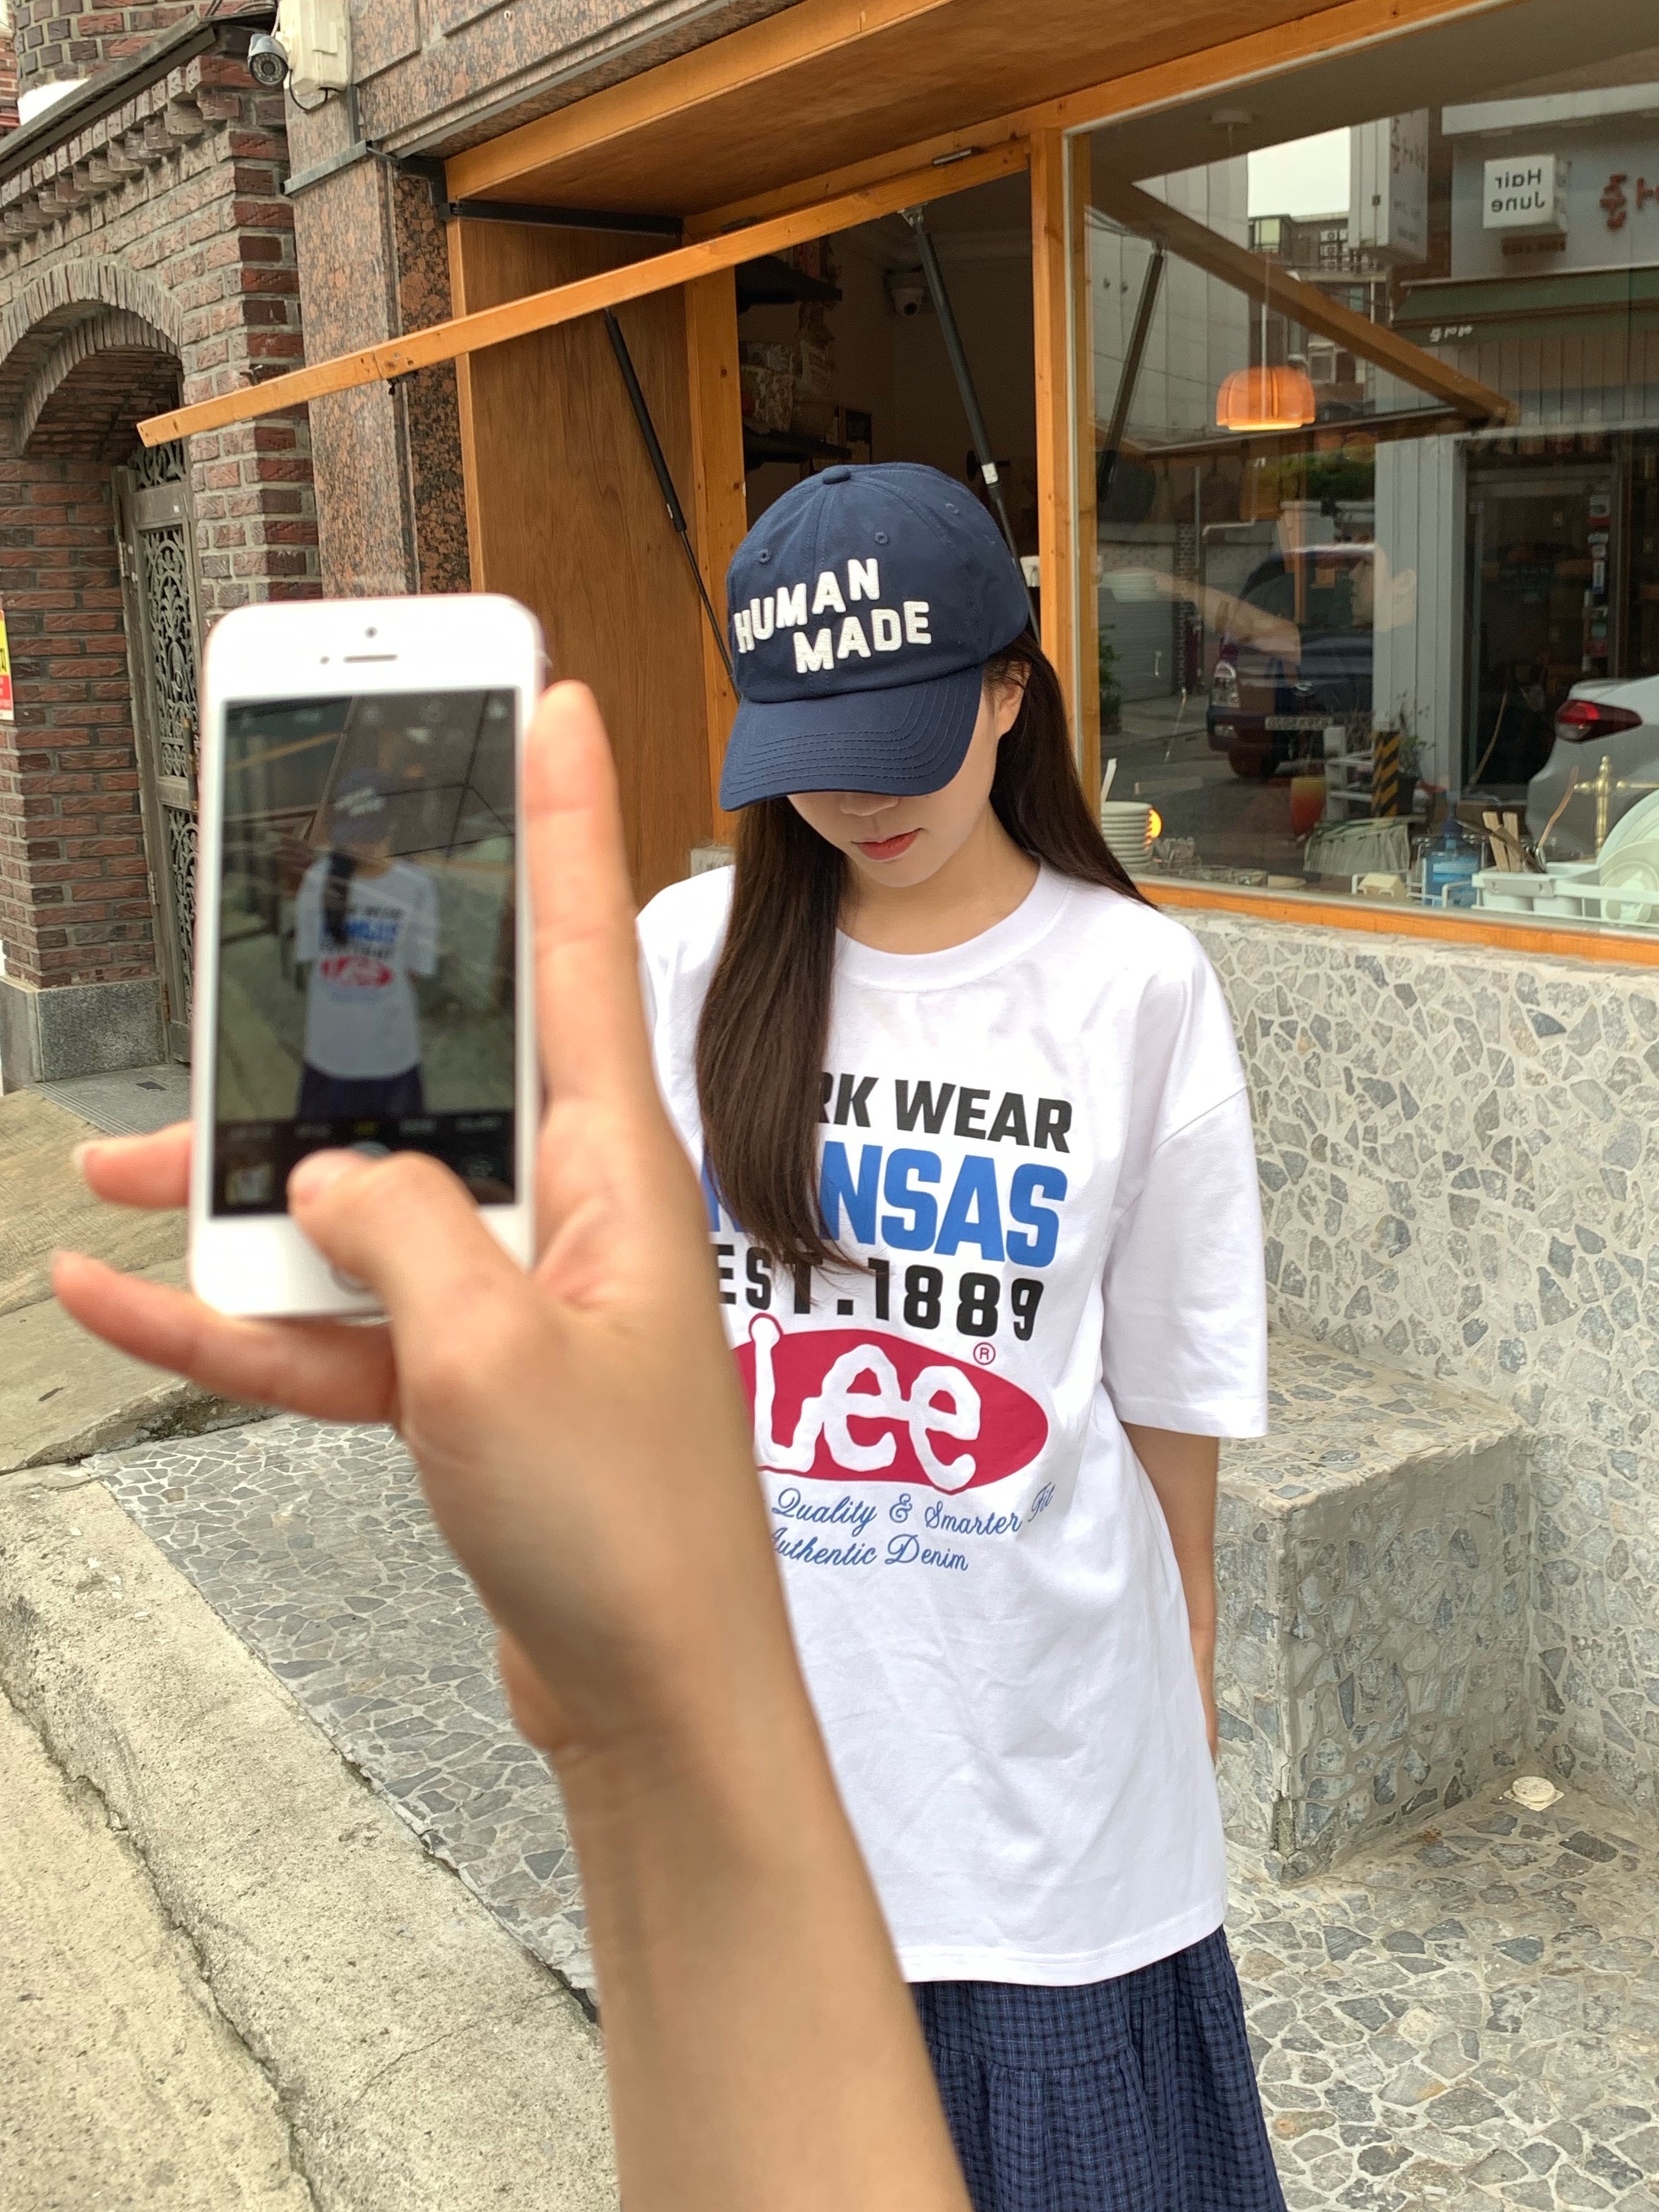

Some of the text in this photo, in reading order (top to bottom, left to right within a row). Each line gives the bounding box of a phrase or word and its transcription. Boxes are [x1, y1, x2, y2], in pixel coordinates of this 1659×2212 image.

[734, 558, 880, 654] HUMAN
[793, 600, 932, 673] MADE
[894, 1079, 1072, 1154] WEAR
[700, 1140, 1068, 1269] NSAS
[752, 1313, 982, 1495] Lee
[771, 1488, 877, 1537] Quality
[889, 1493, 913, 1524] &
[924, 1501, 1023, 1536] Smarter
[884, 1533, 969, 1572] Denim
